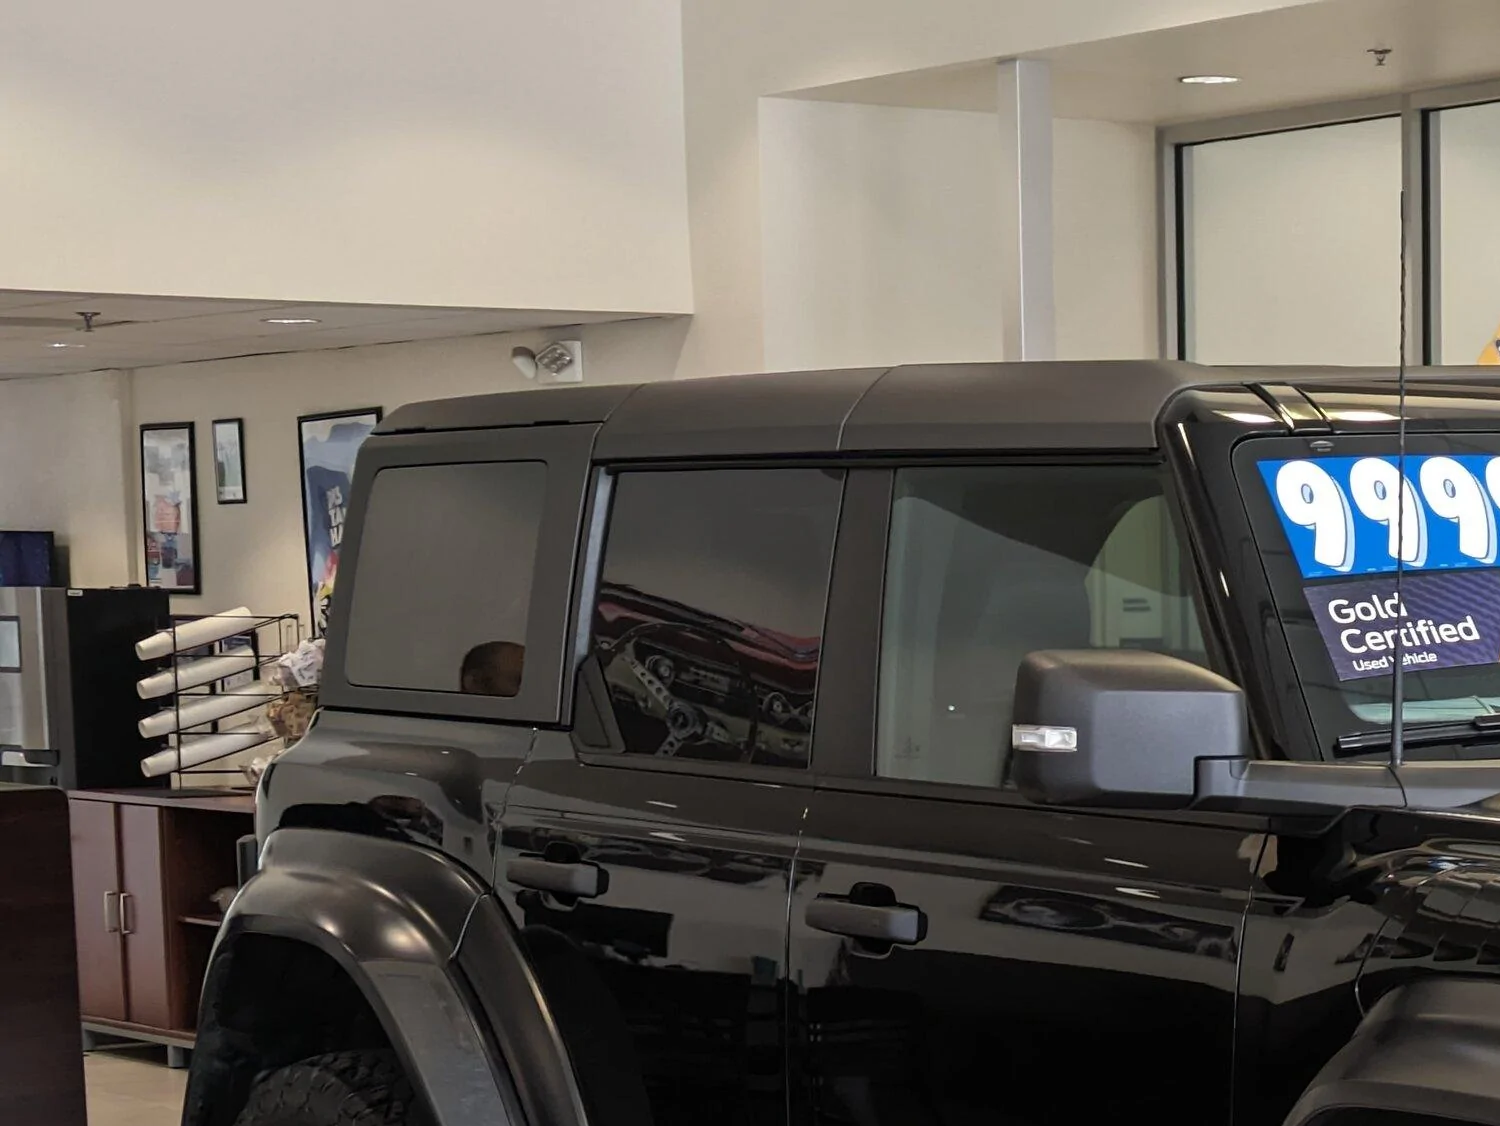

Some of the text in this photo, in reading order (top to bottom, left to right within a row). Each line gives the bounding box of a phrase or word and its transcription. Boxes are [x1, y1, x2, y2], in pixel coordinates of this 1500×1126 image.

[1328, 592, 1408, 624] Gold
[1340, 615, 1481, 654] Certified
[1352, 655, 1389, 672] Used
